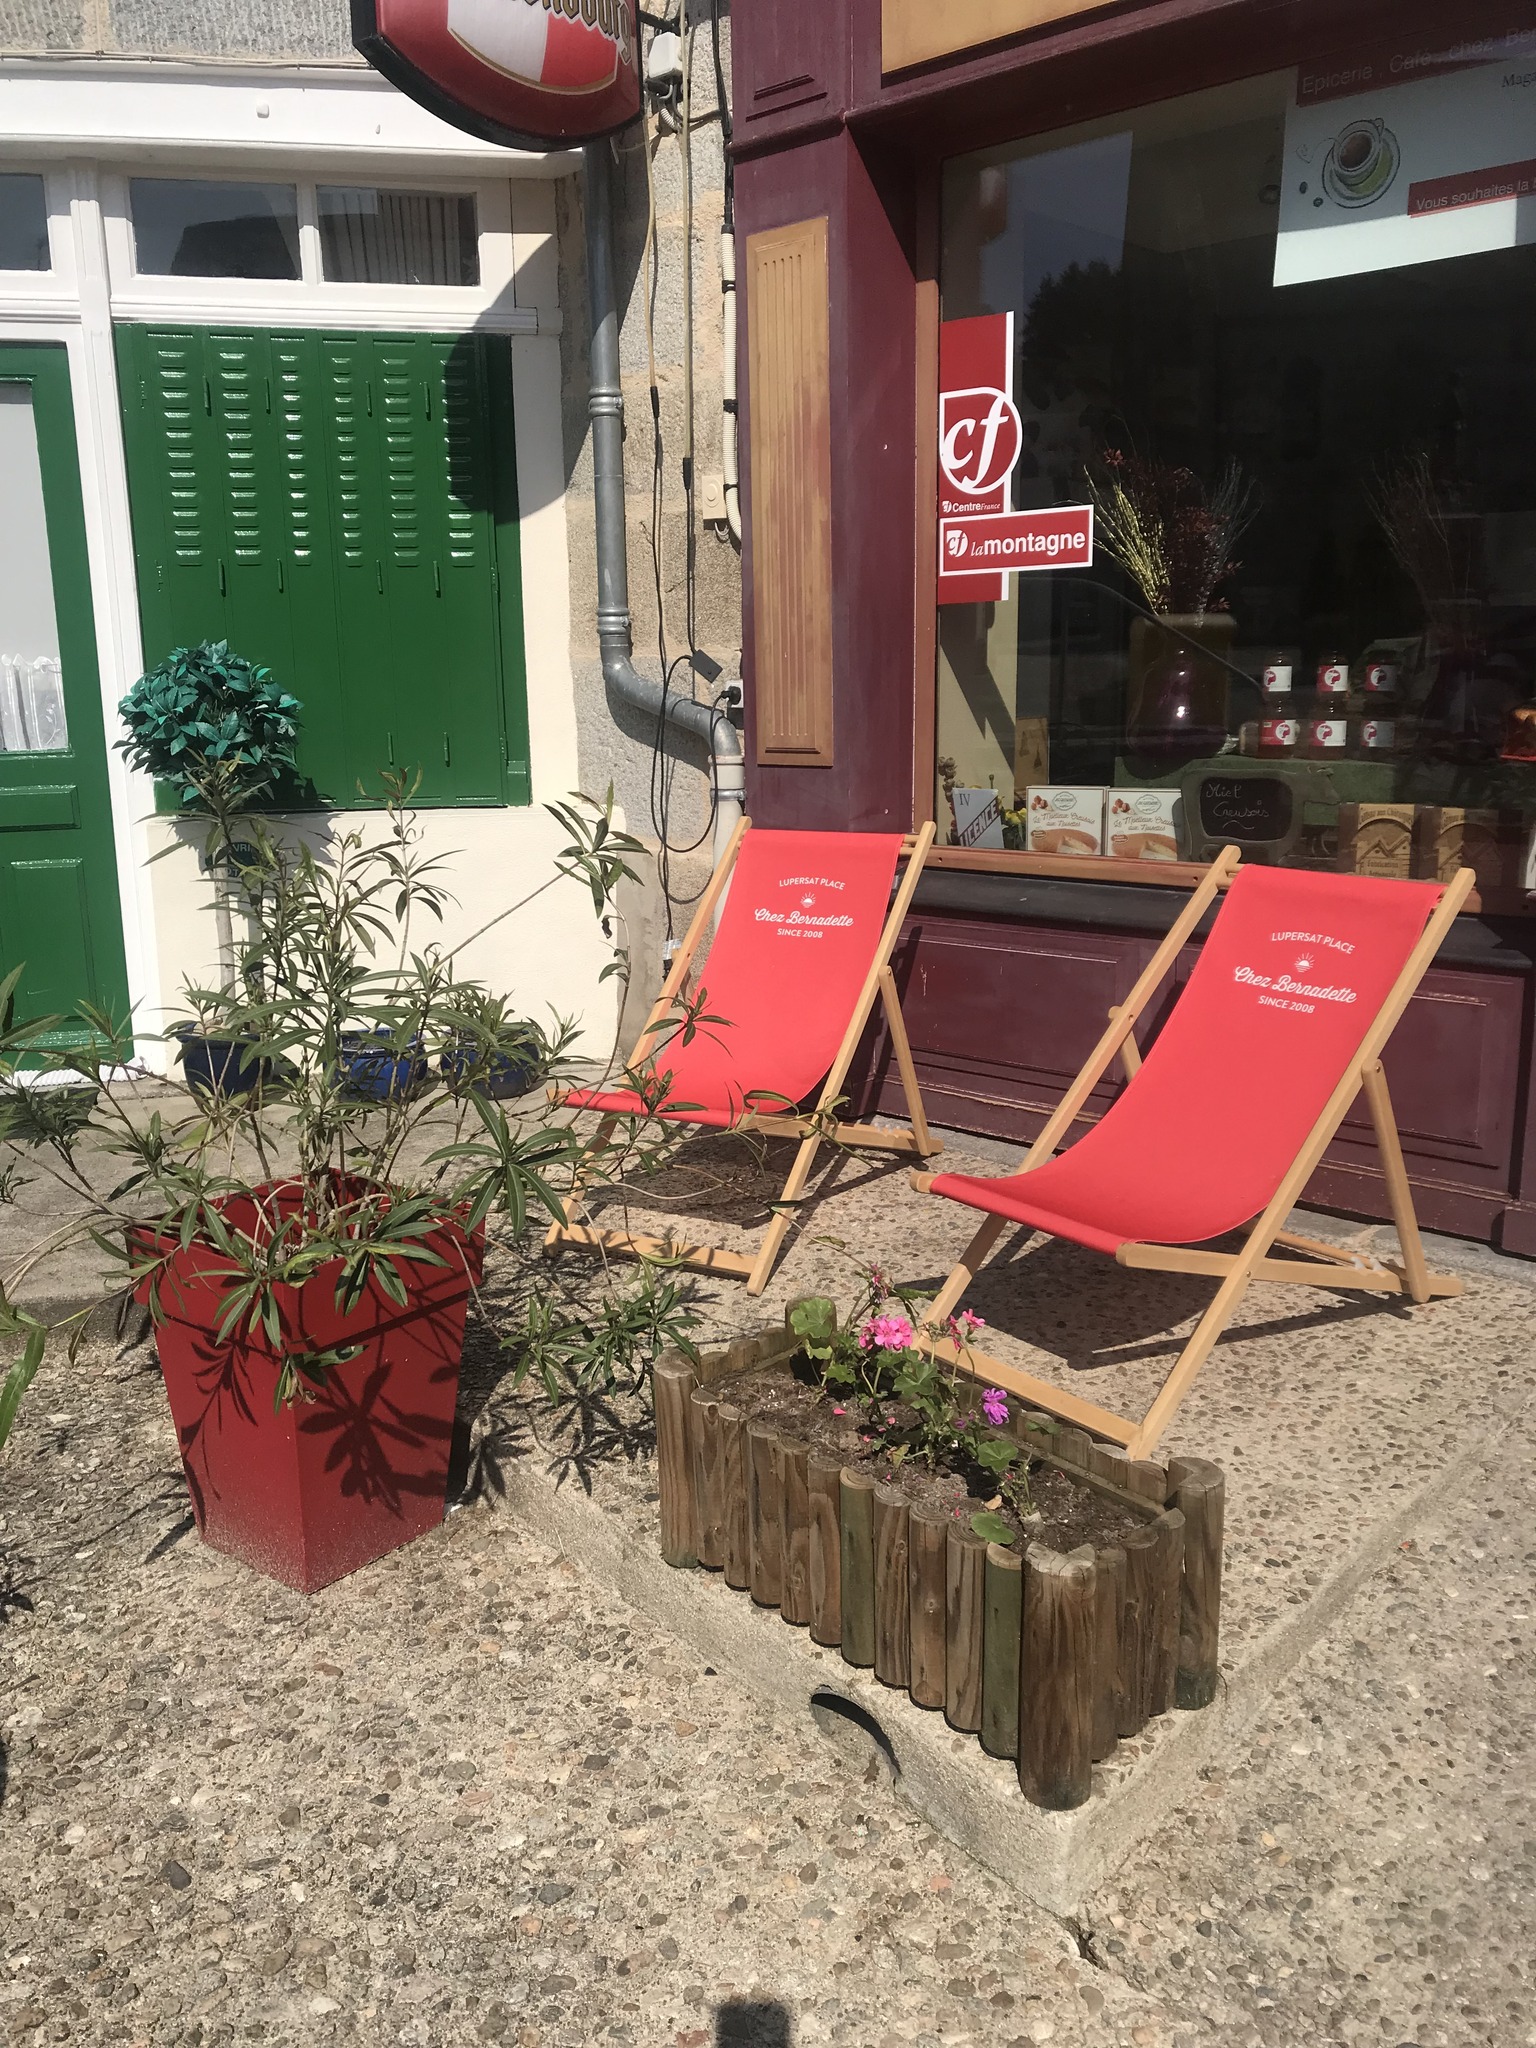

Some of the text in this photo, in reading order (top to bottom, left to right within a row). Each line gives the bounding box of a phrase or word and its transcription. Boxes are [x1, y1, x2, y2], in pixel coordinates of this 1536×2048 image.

[1416, 195, 1448, 211] Vous
[1451, 182, 1514, 205] souhaites
[959, 793, 971, 806] IV
[779, 876, 846, 891] LUPERSAT PLACE
[754, 907, 854, 927] Chez Bernadette
[777, 927, 823, 939] SINCE 2008
[1271, 931, 1356, 955] LUPERSAT PLACE
[1234, 965, 1357, 1004] Chez Bernadette
[1258, 995, 1316, 1014] SINCE 2008
